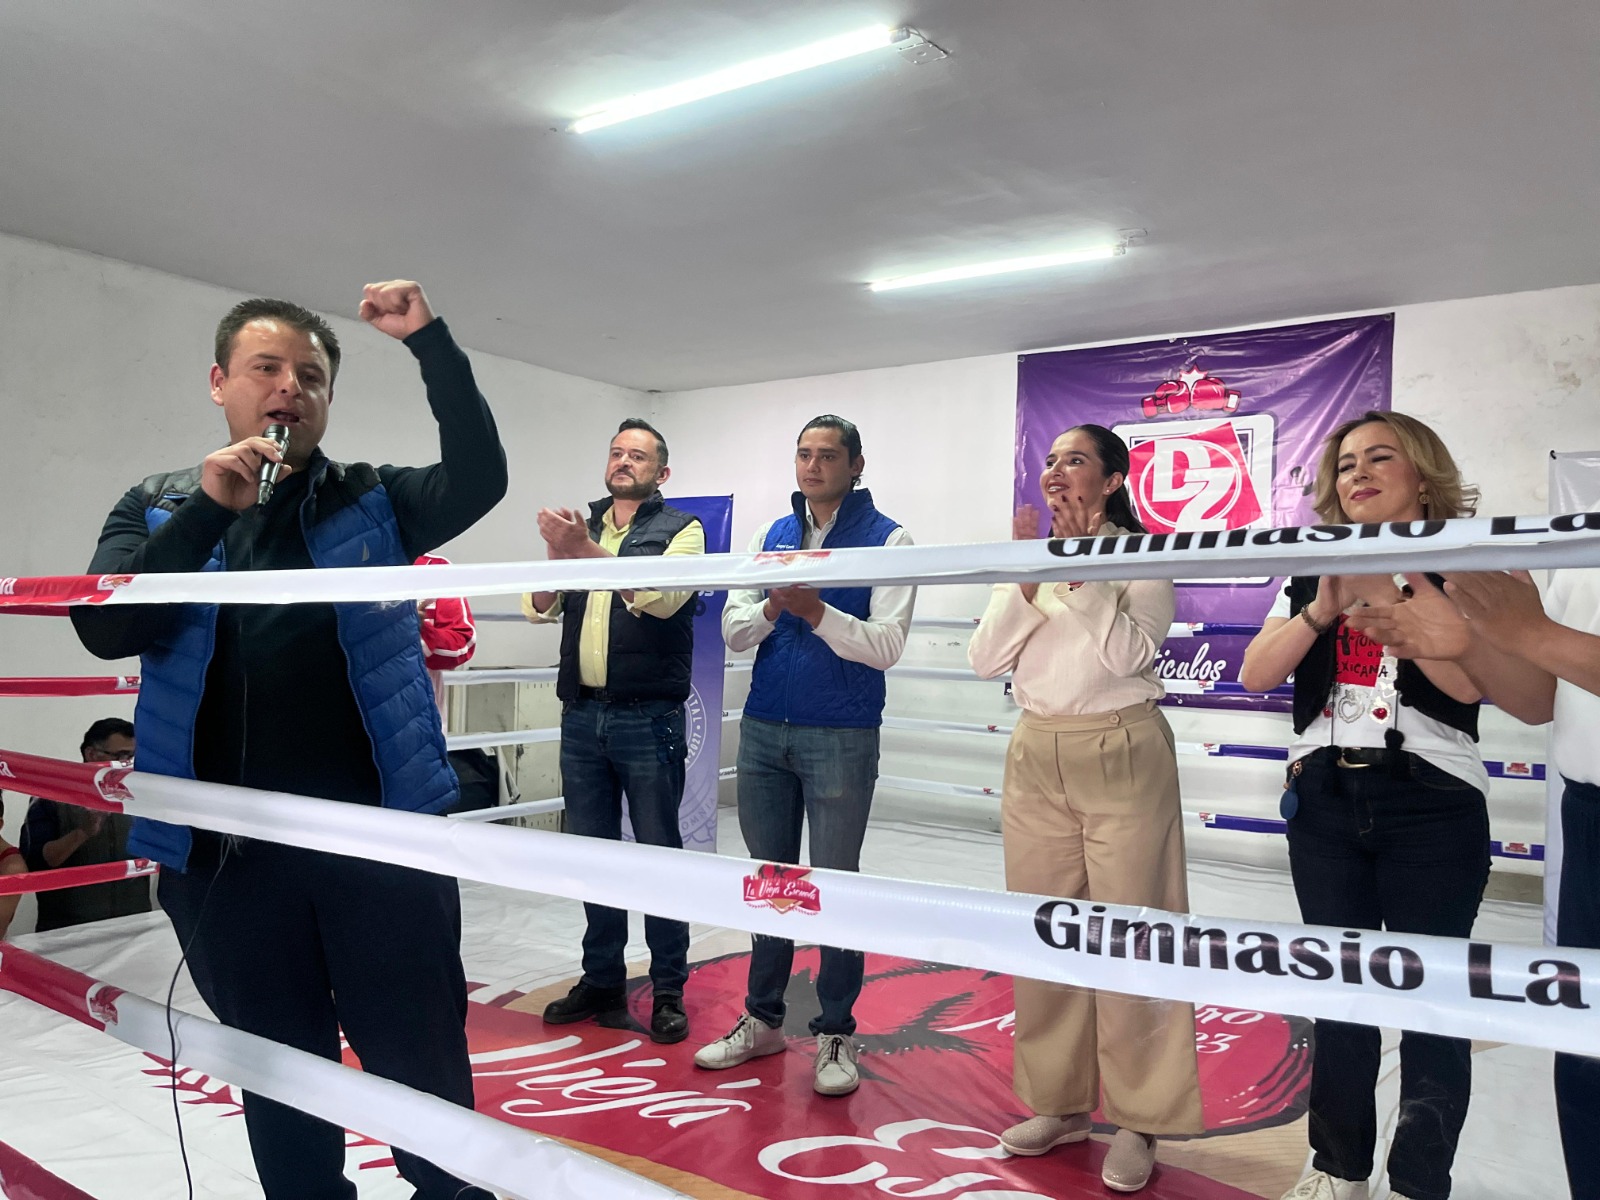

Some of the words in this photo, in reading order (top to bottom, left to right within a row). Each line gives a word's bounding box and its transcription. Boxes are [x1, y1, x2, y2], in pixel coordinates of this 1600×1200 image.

[1154, 642, 1227, 682] iculos
[1335, 660, 1389, 678] EXICANA
[686, 693, 702, 723] ITAL
[1034, 900, 1424, 990] Gimnasio
[1468, 942, 1590, 1009] La
